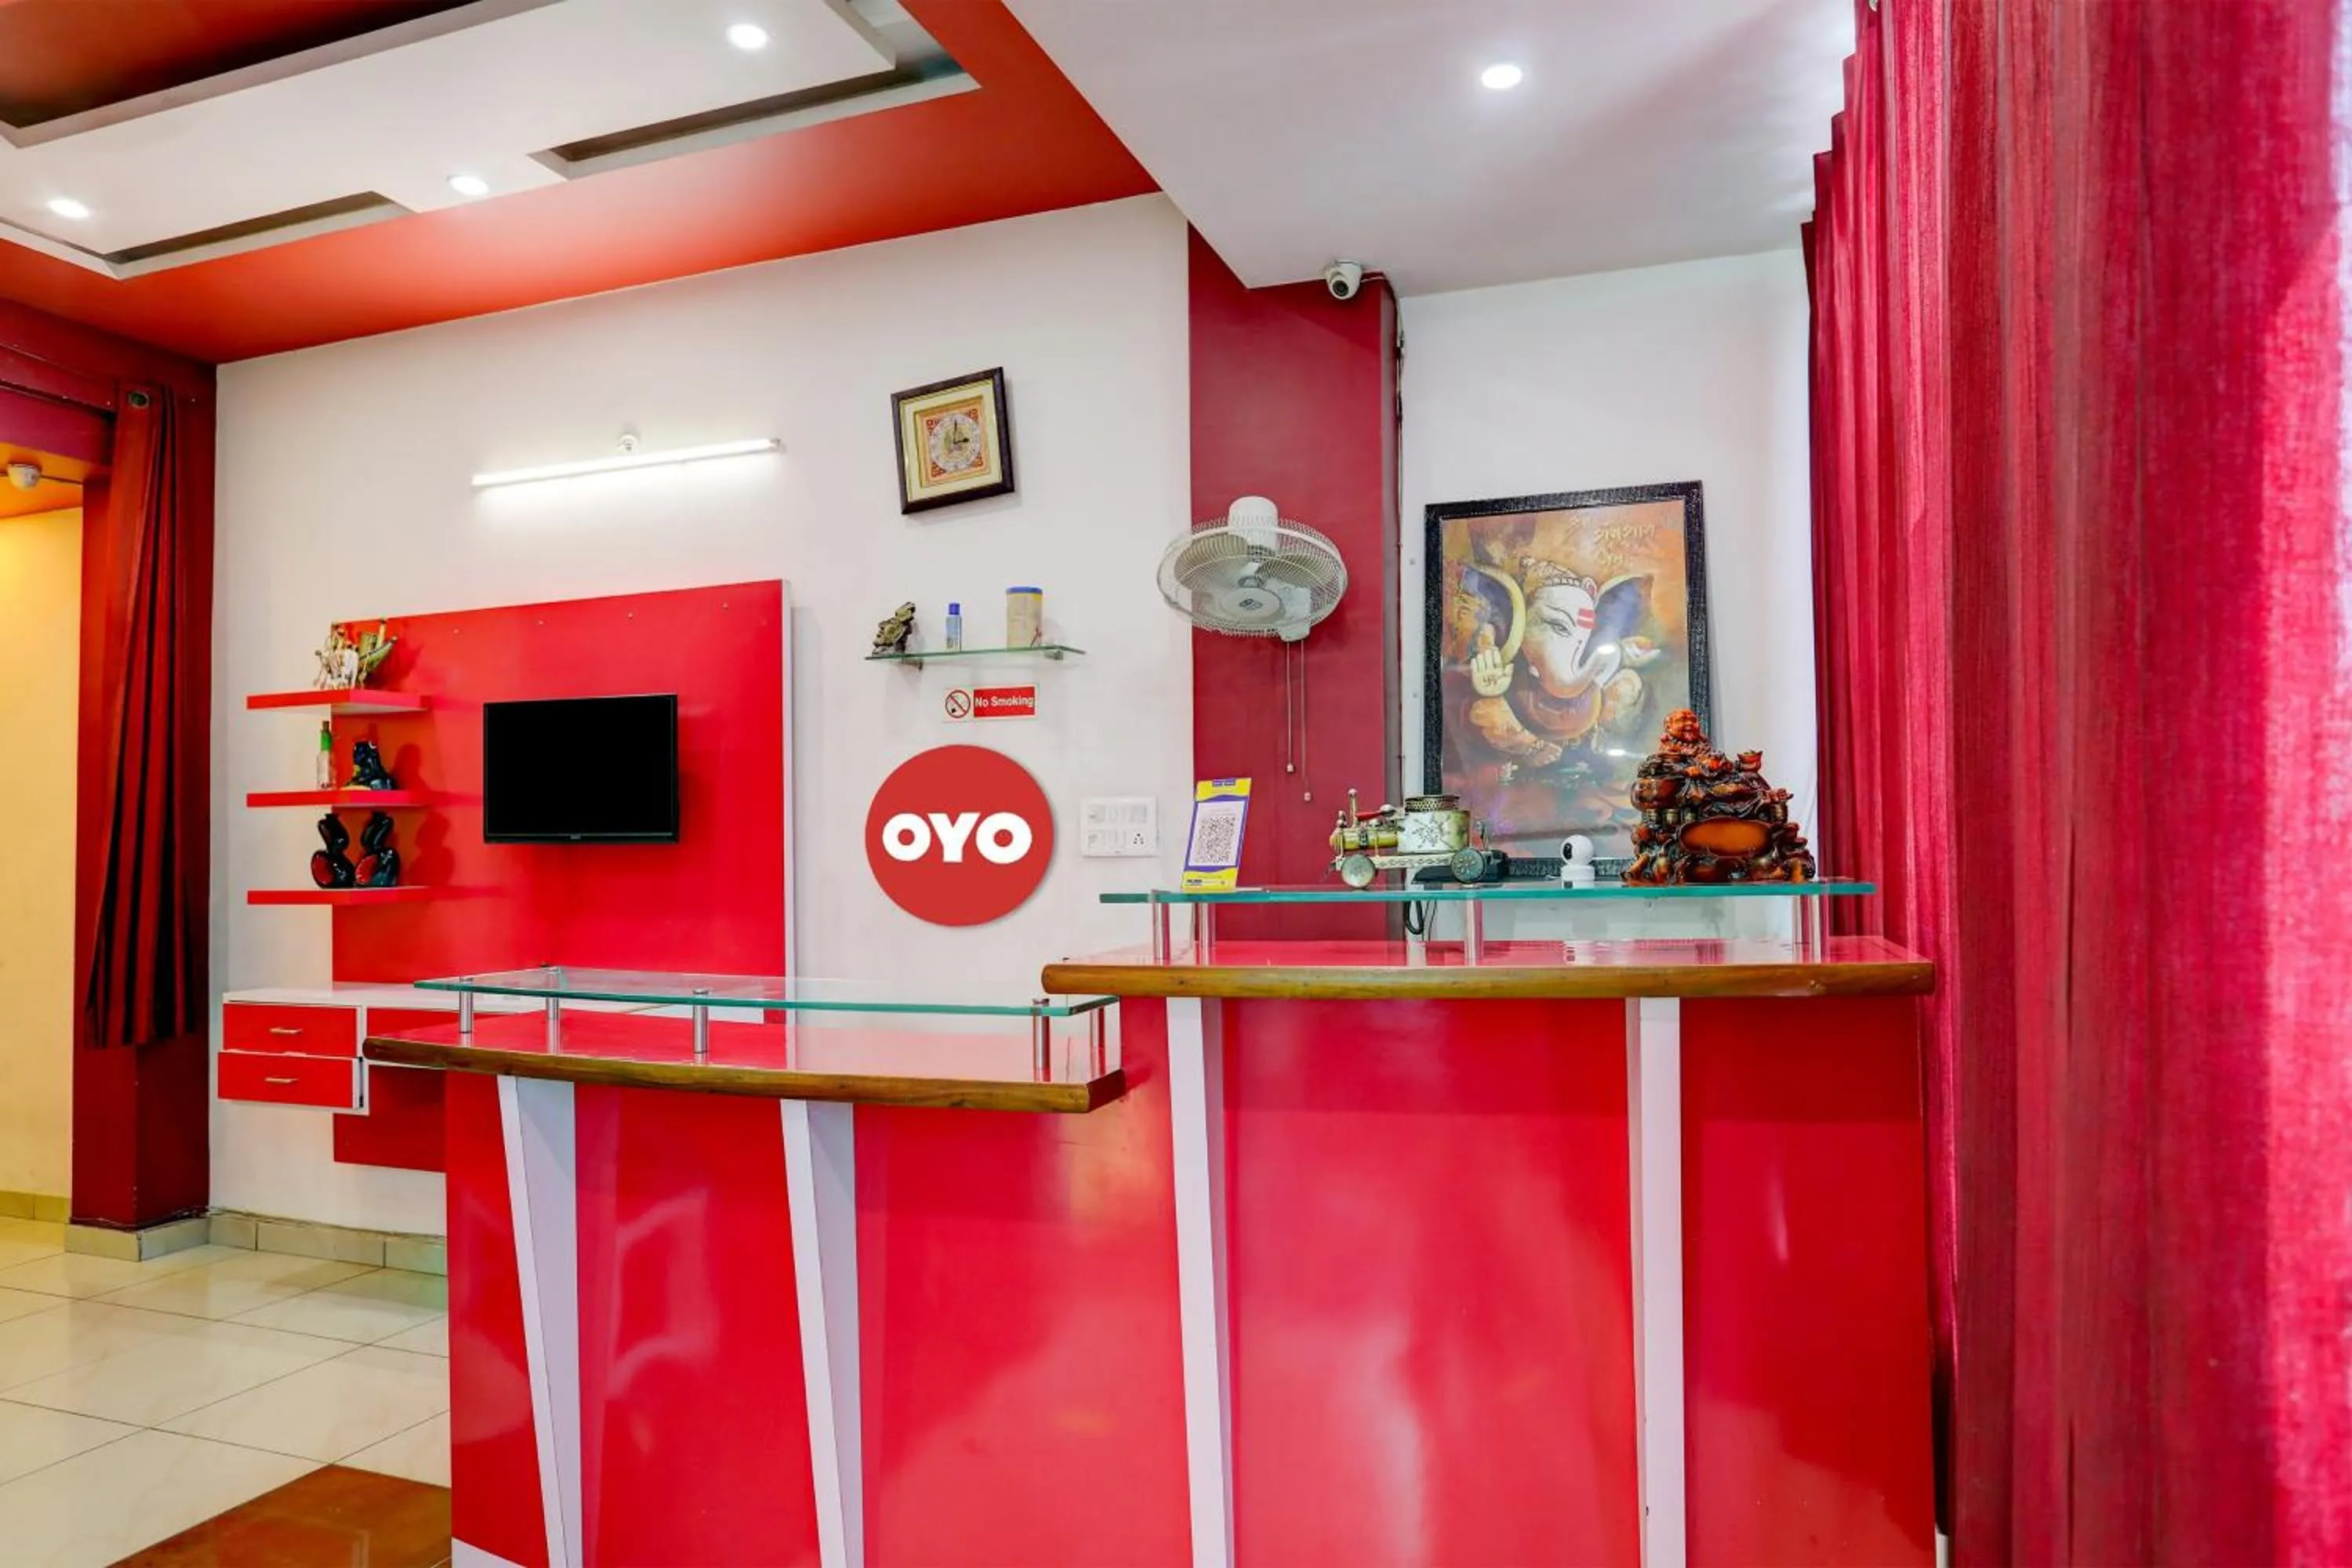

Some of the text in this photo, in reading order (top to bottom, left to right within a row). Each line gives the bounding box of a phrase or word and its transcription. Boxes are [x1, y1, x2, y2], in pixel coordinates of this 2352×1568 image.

[975, 695, 1034, 709] No Smoking
[882, 811, 1033, 865] OYO
